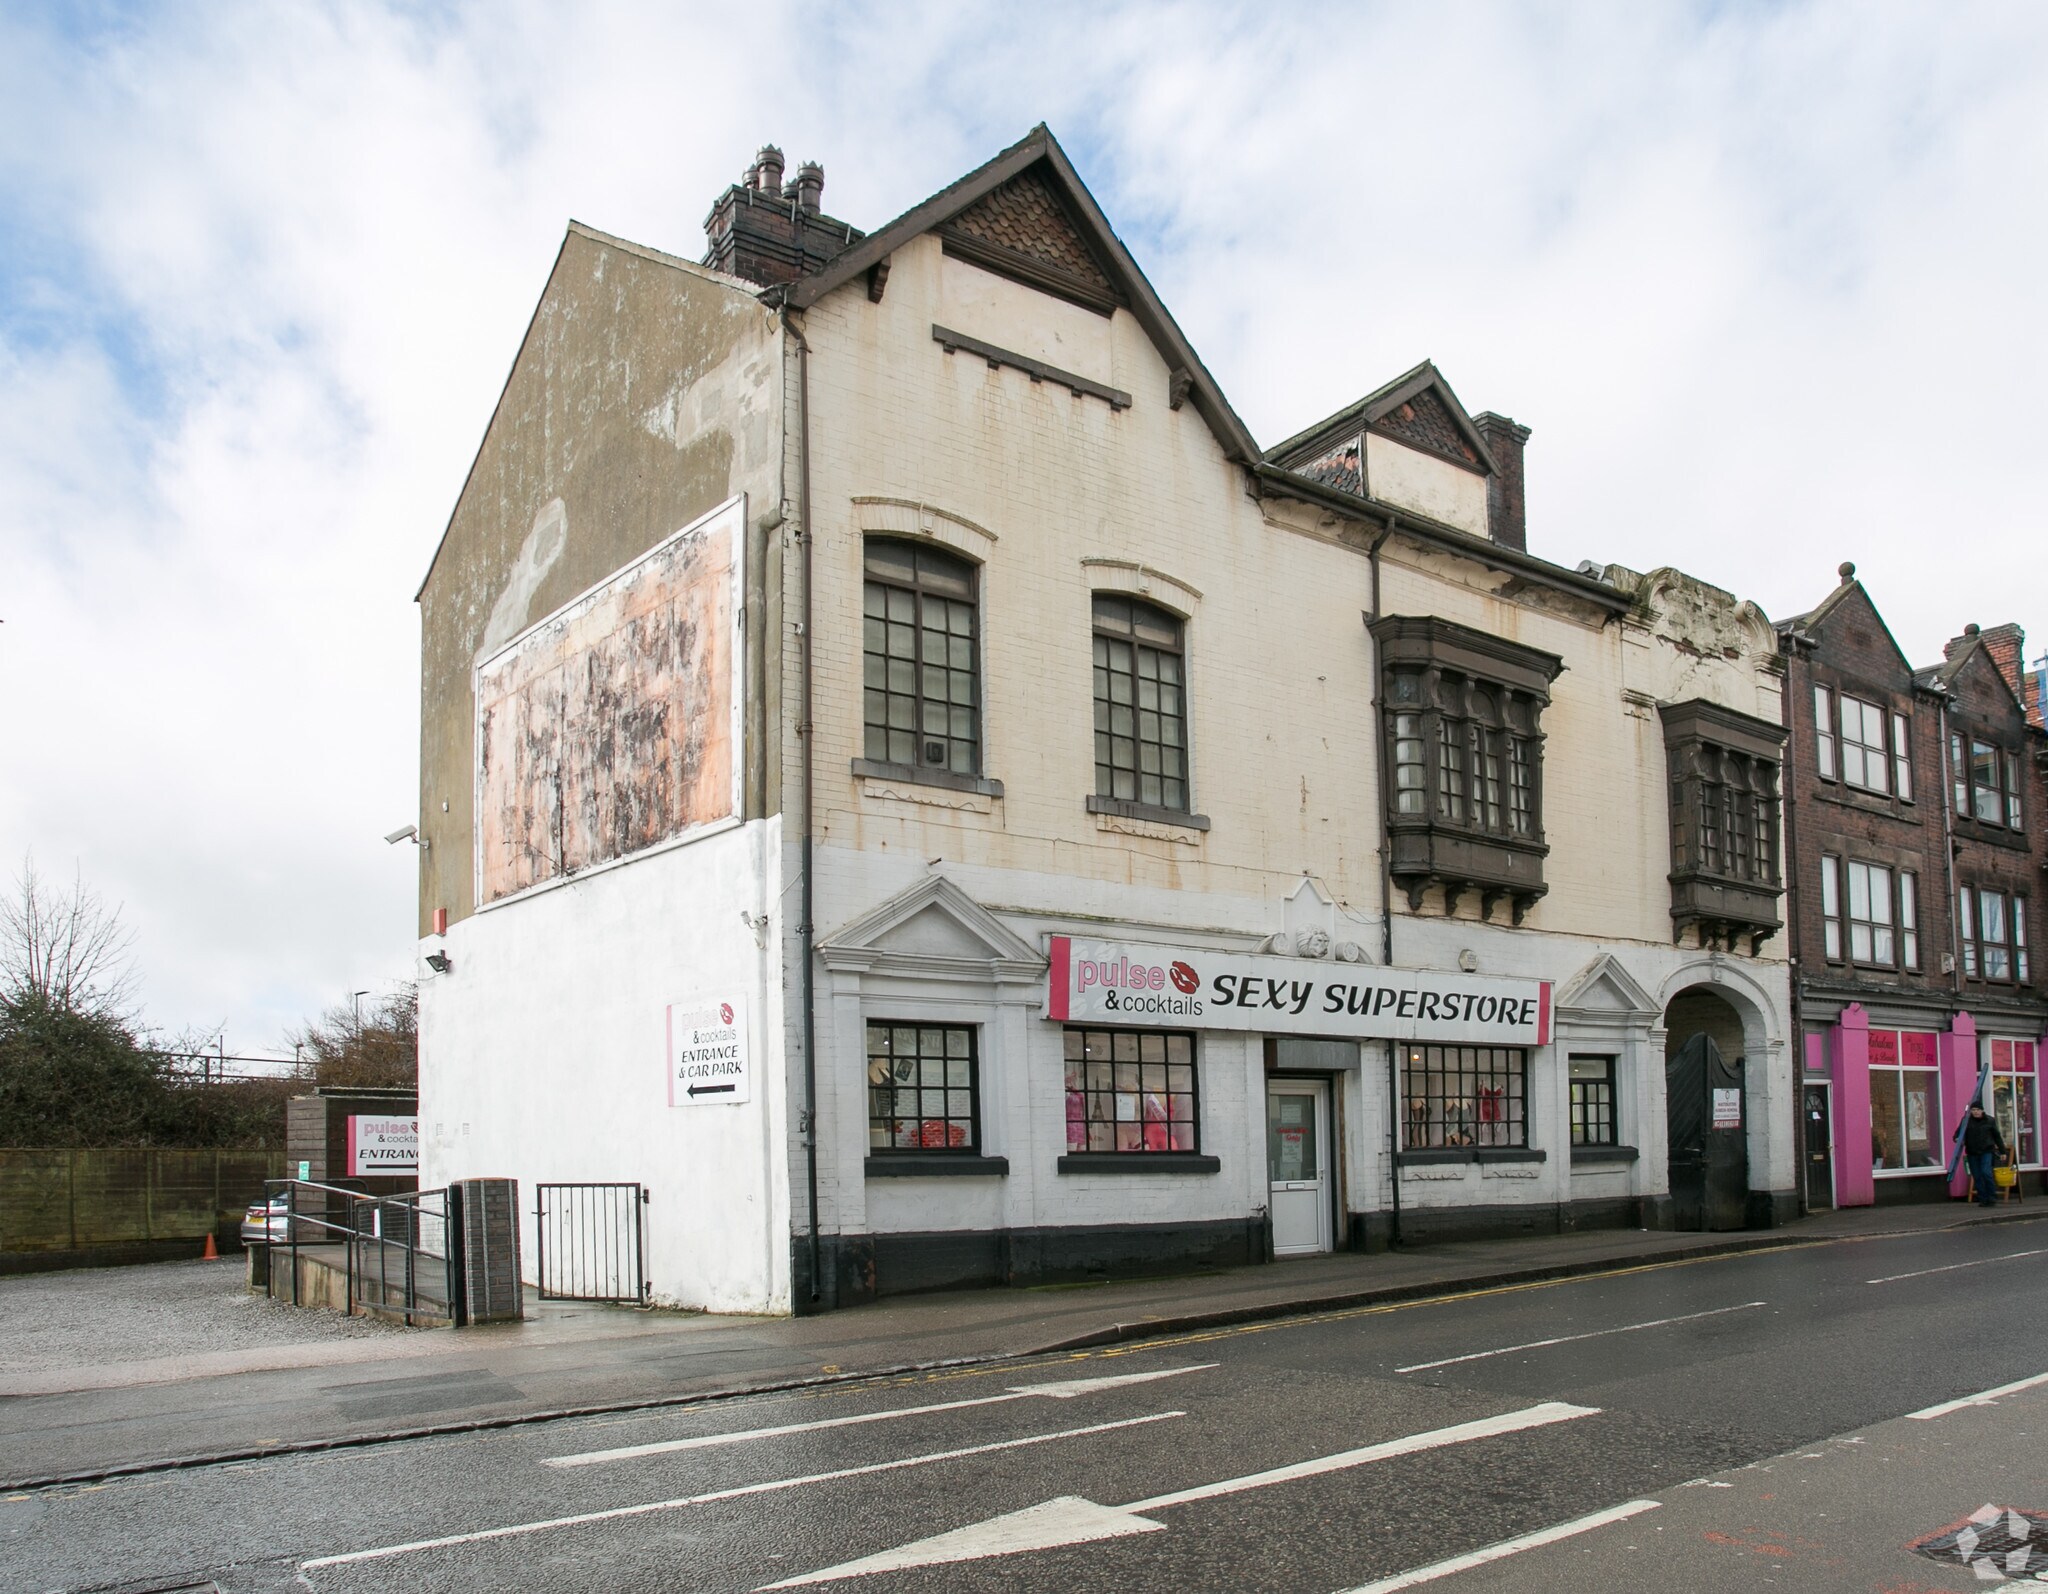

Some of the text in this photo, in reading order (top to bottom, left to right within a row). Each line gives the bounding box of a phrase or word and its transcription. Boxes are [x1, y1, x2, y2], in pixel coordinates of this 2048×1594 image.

[1078, 956, 1165, 993] pulse
[1105, 989, 1203, 1016] & cocktails
[1322, 983, 1537, 1026] SUPERSTORE
[682, 1006, 719, 1036] pulse
[693, 1027, 737, 1044] & cocktails
[682, 1045, 739, 1063] ENTRANCE
[679, 1061, 742, 1078] & CAR PARK
[364, 1121, 409, 1136] pulse
[378, 1134, 385, 1143] &
[359, 1149, 418, 1159] ENTRAN
